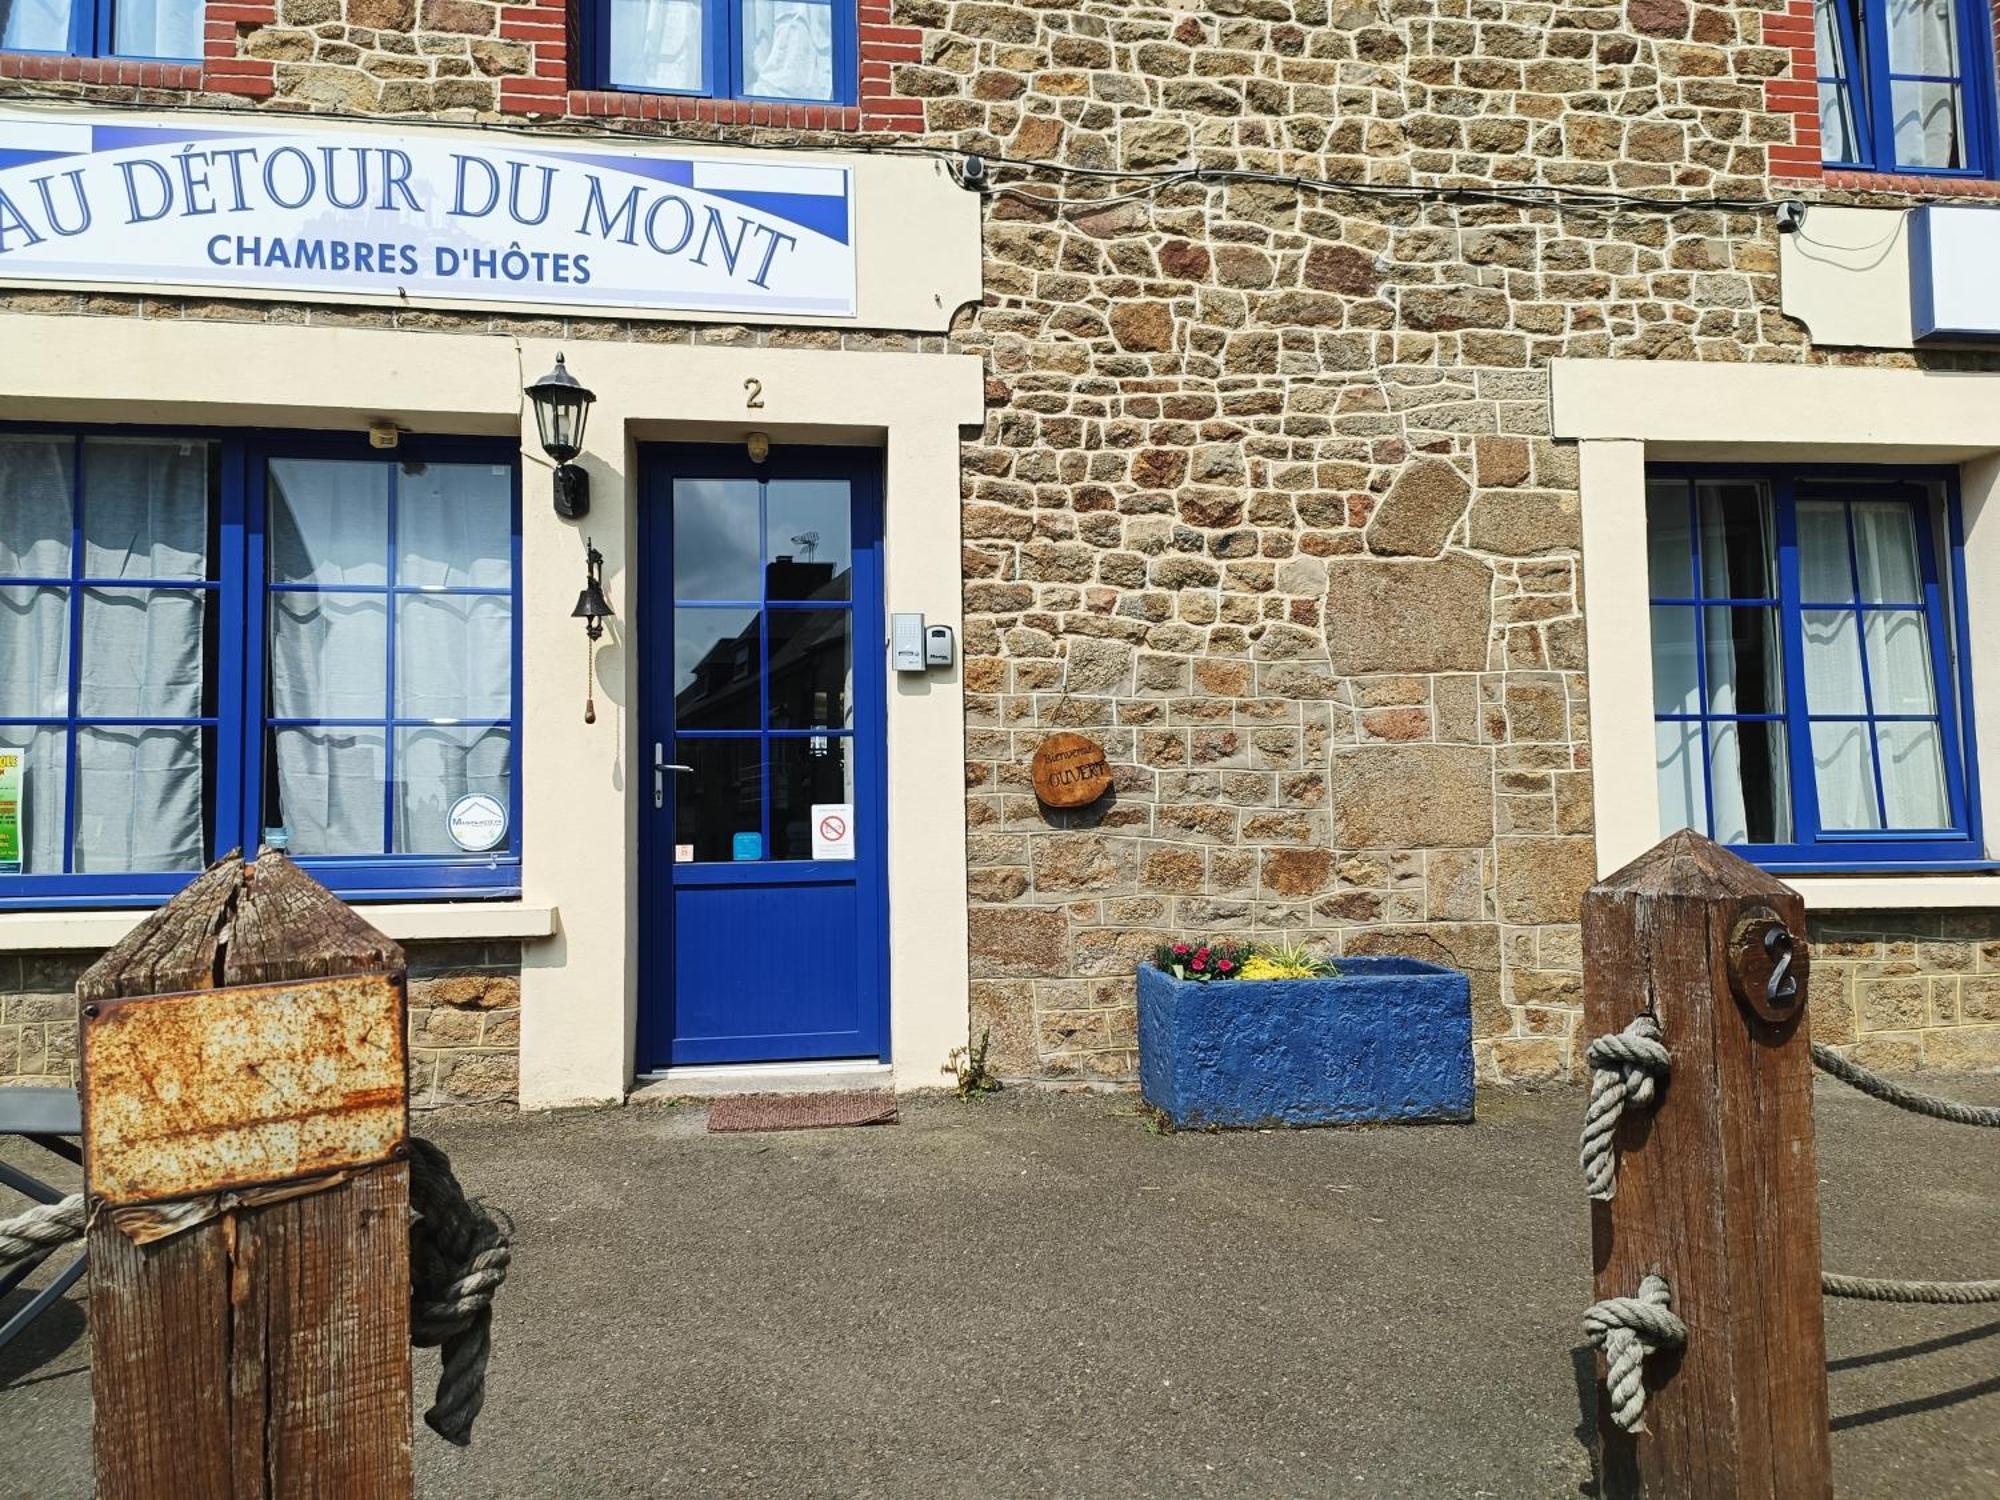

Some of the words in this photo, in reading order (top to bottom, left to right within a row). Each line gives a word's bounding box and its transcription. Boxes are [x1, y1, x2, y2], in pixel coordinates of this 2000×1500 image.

[0, 168, 92, 254] AU
[113, 143, 425, 225] DÉTOUR
[446, 153, 560, 226] DU
[575, 174, 797, 290] MONT
[206, 233, 419, 276] CHAMBRES
[435, 241, 591, 285] D'HÔTES
[743, 377, 765, 409] 2
[1048, 759, 1105, 788] OUVERT
[1764, 925, 1797, 1006] 2
